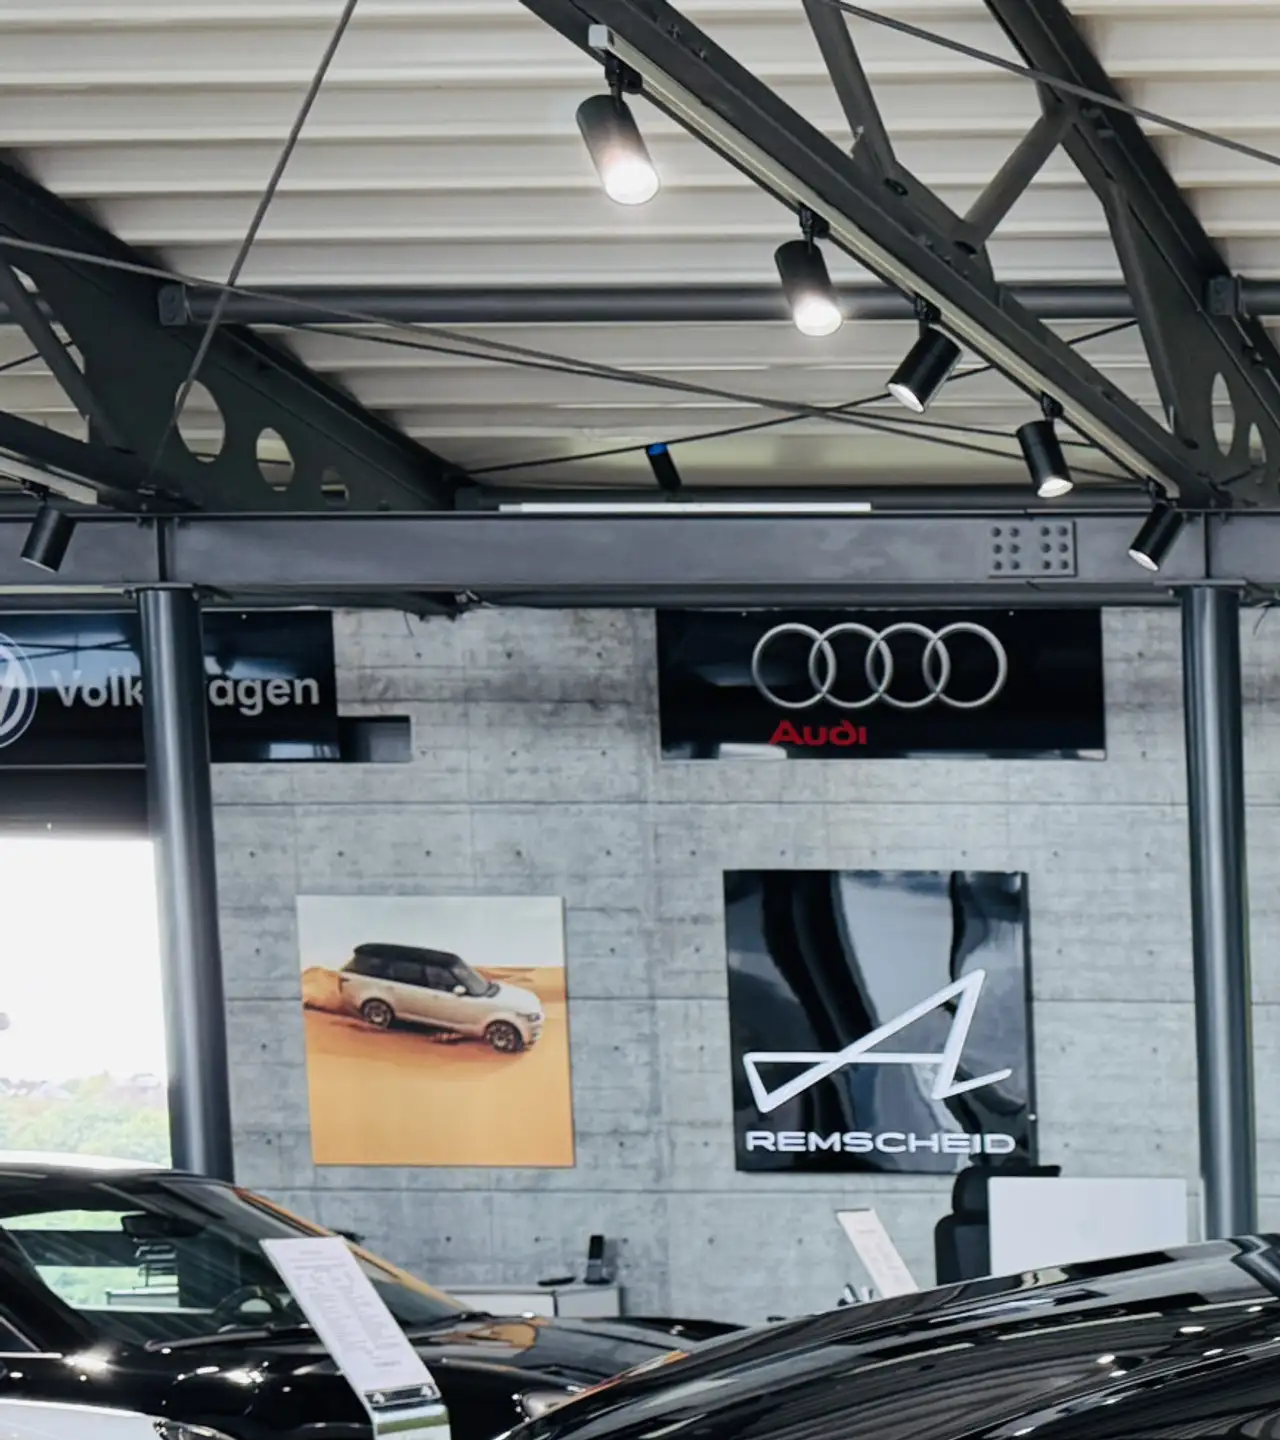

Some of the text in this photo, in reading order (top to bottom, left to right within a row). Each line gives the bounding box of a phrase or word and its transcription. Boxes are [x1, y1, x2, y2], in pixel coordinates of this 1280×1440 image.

[50, 666, 320, 717] Volkagen
[769, 719, 868, 748] Audi
[745, 1130, 1017, 1156] REMSCHEID
